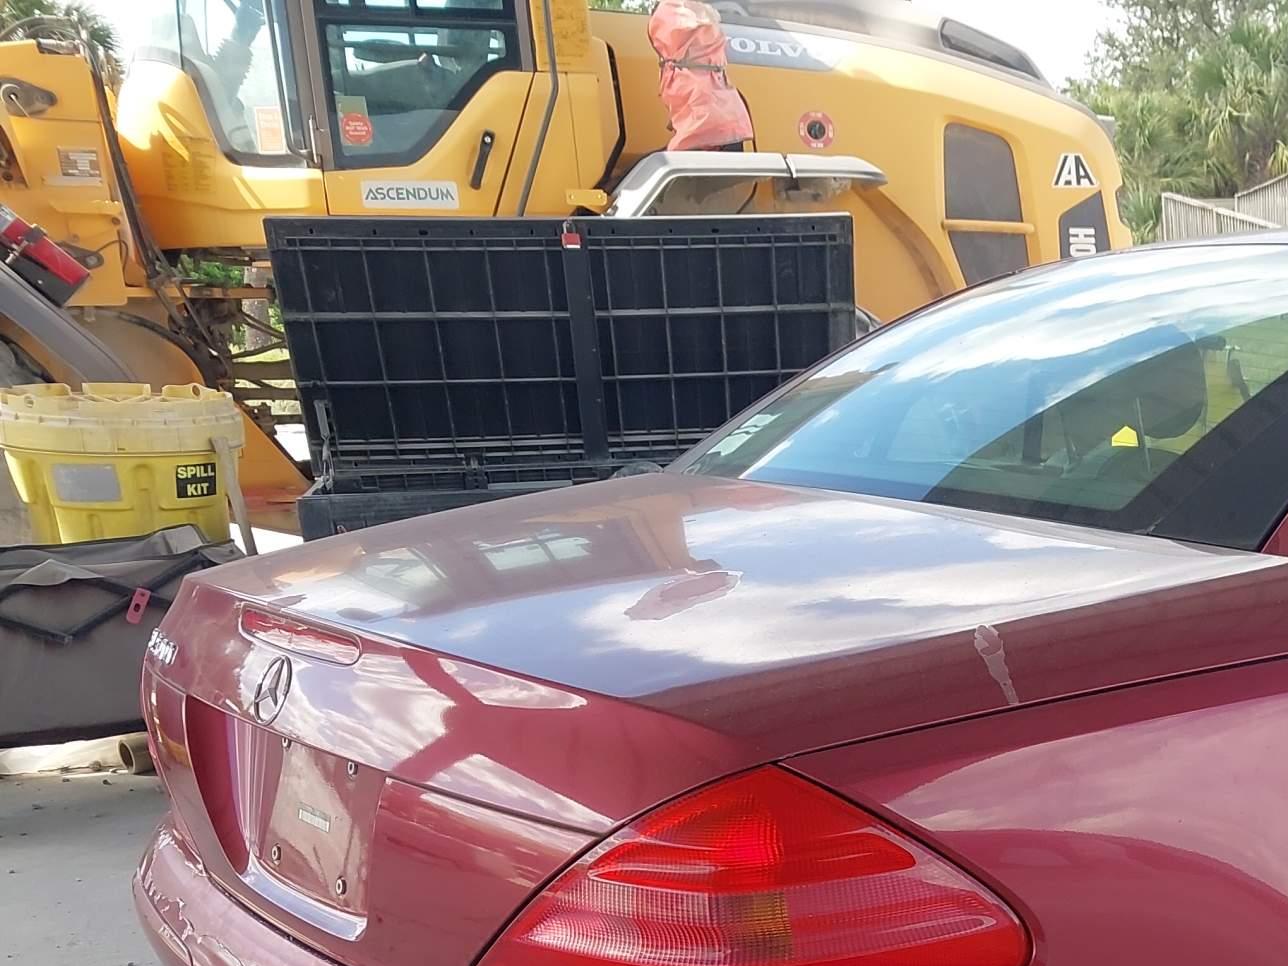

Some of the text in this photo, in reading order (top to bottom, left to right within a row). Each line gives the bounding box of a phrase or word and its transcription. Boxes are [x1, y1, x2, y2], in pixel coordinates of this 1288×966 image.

[365, 187, 455, 201] ASCENDUM
[177, 465, 215, 479] SPILL
[186, 483, 209, 497] KIT
